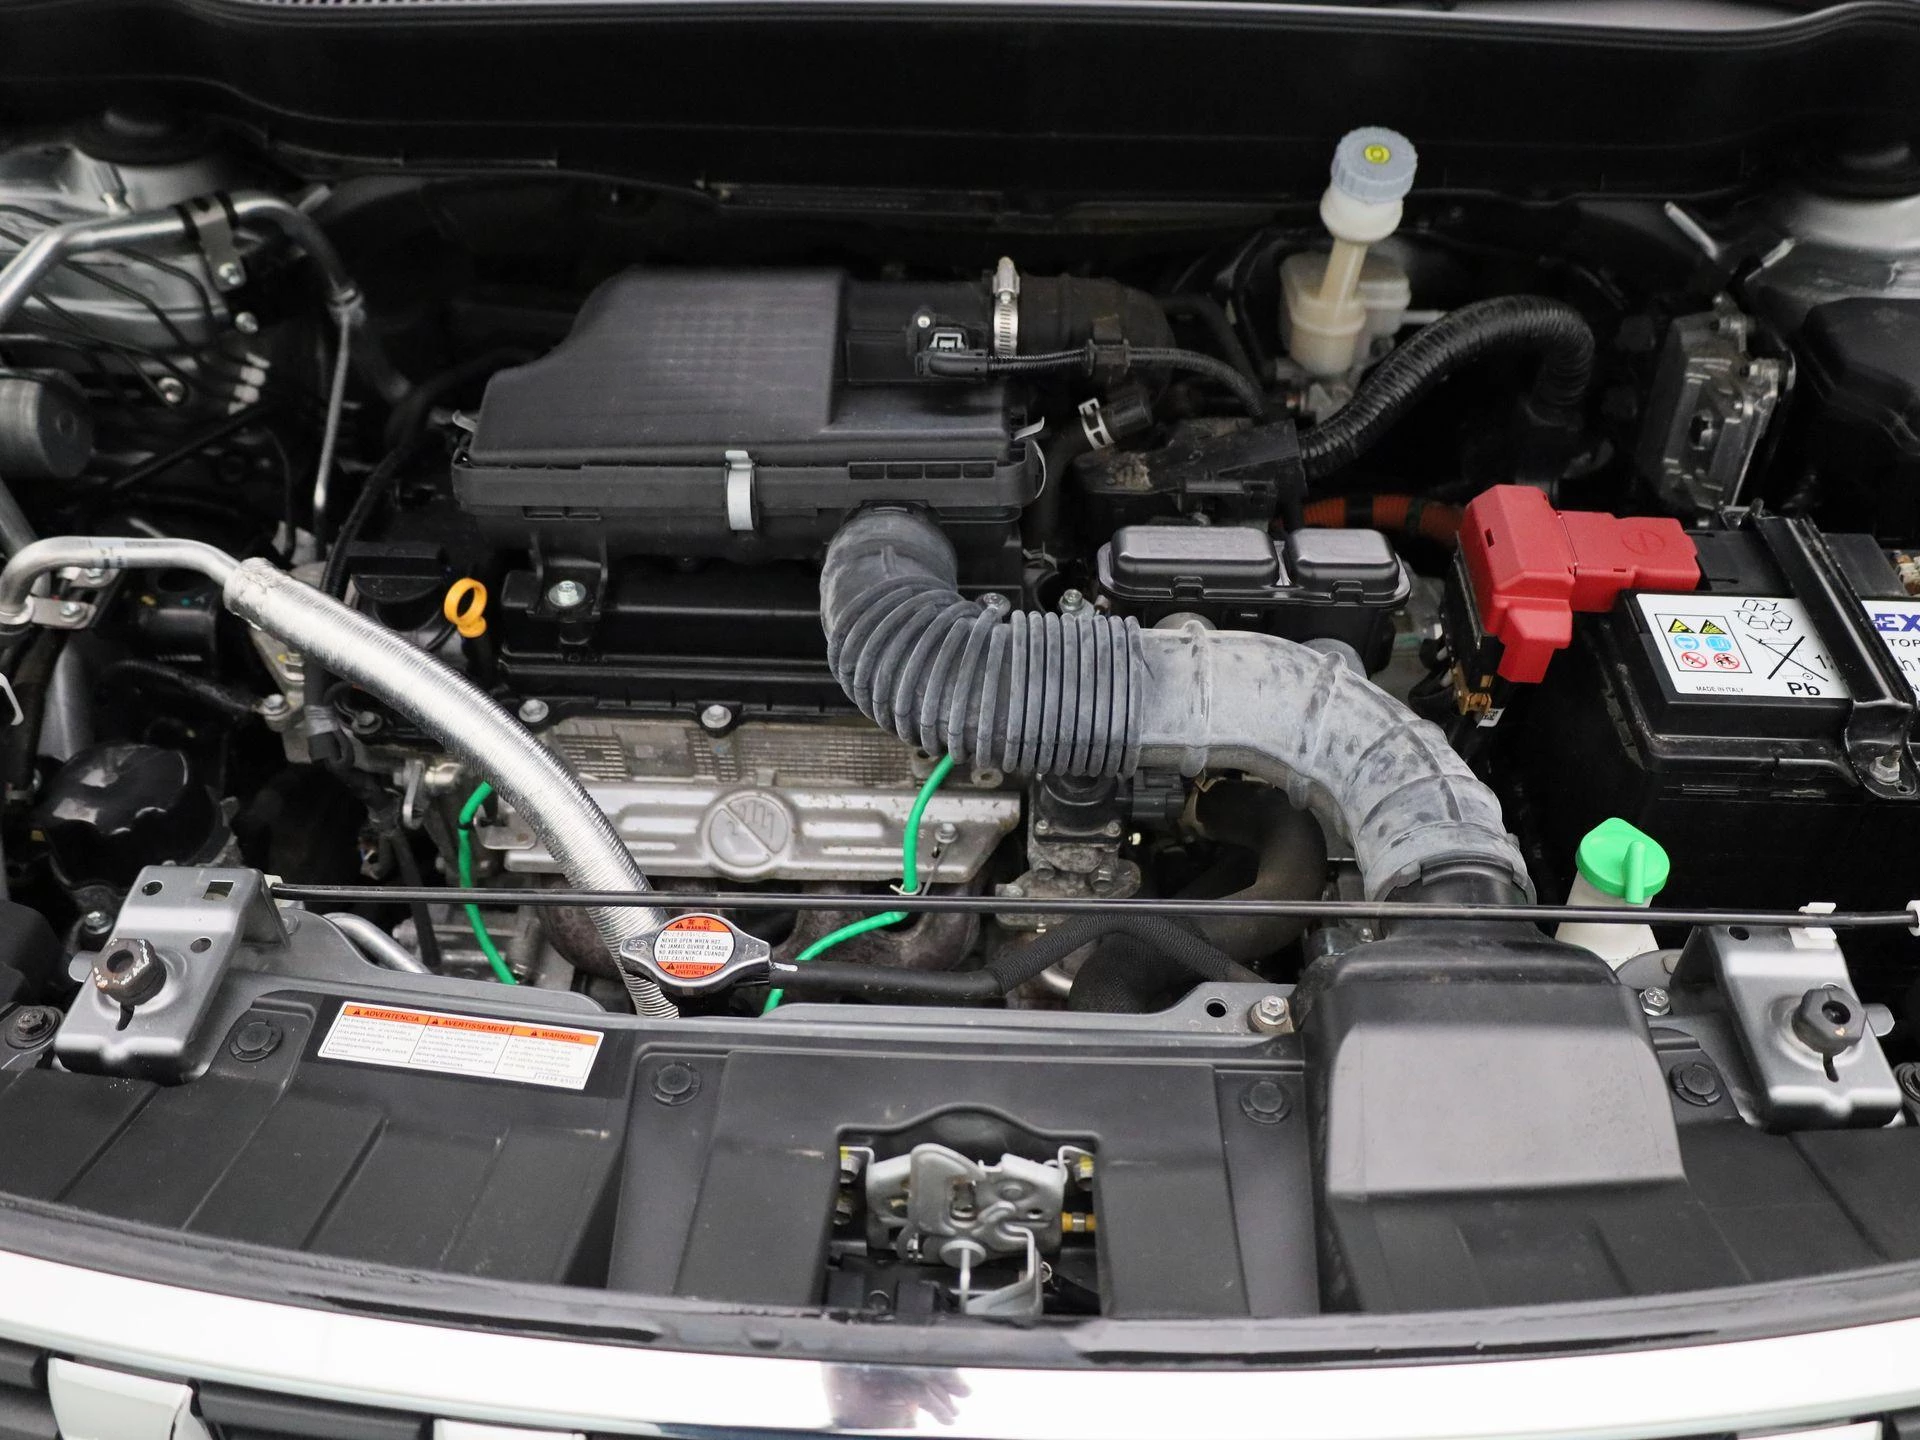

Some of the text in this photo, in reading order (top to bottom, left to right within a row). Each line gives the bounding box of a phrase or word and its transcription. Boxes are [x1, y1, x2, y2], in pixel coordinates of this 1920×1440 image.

[1787, 682, 1821, 696] Pb
[364, 1009, 420, 1022] ADVERTENCIA
[443, 1019, 510, 1033] AVERTISSEMENT
[541, 1031, 581, 1042] WARNING
